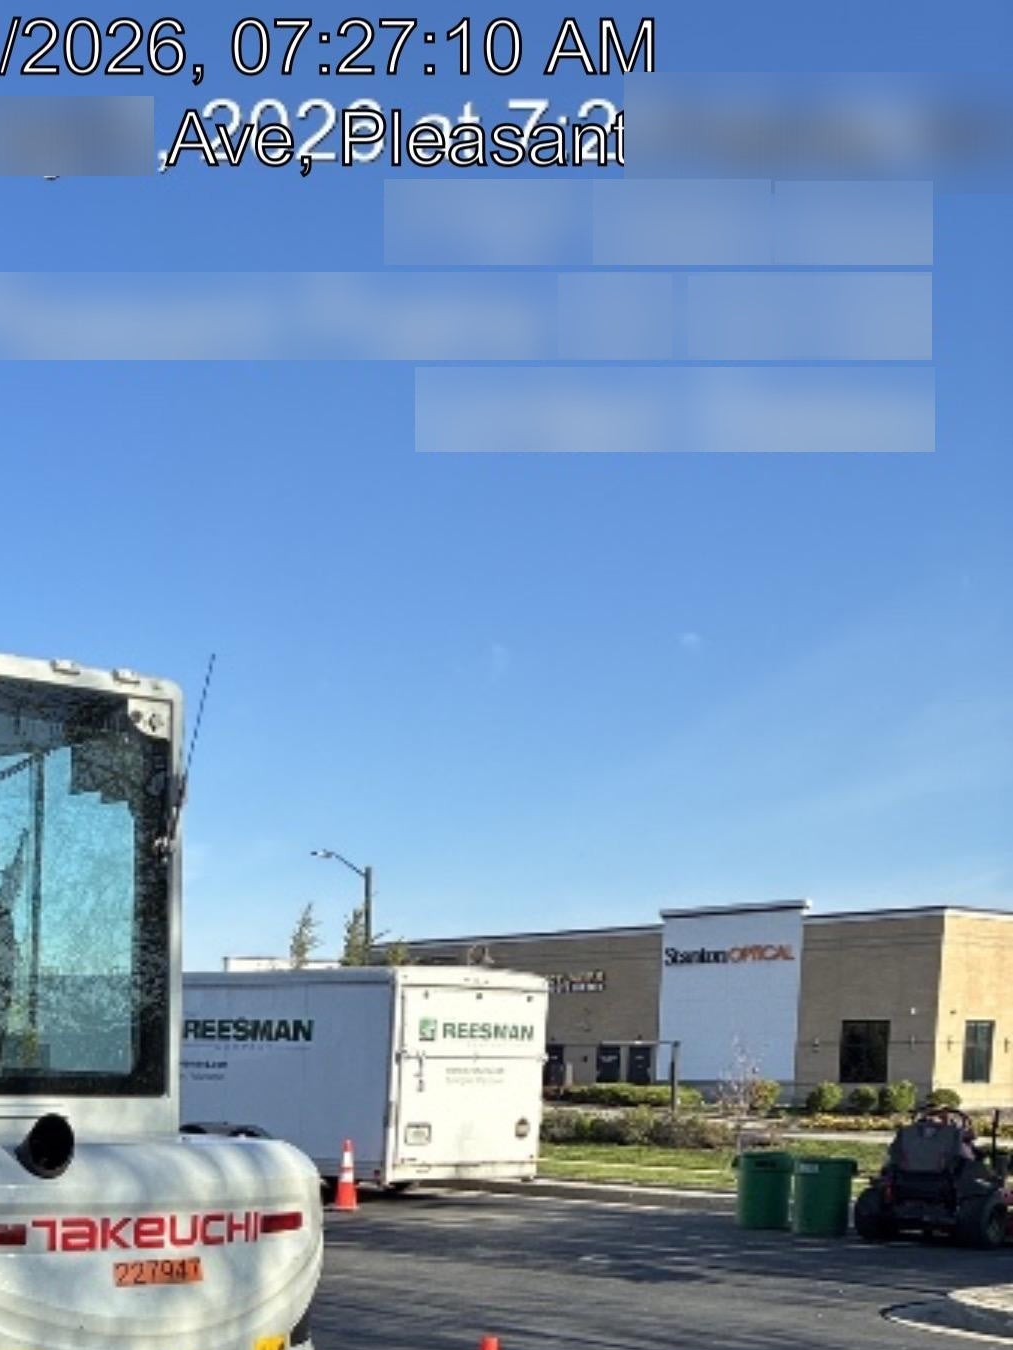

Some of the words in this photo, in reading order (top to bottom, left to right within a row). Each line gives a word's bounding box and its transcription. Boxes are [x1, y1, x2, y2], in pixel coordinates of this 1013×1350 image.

[183, 1018, 315, 1042] REESMAN
[442, 1022, 535, 1041] REESMAN
[31, 1211, 258, 1252] TAKEUCHI
